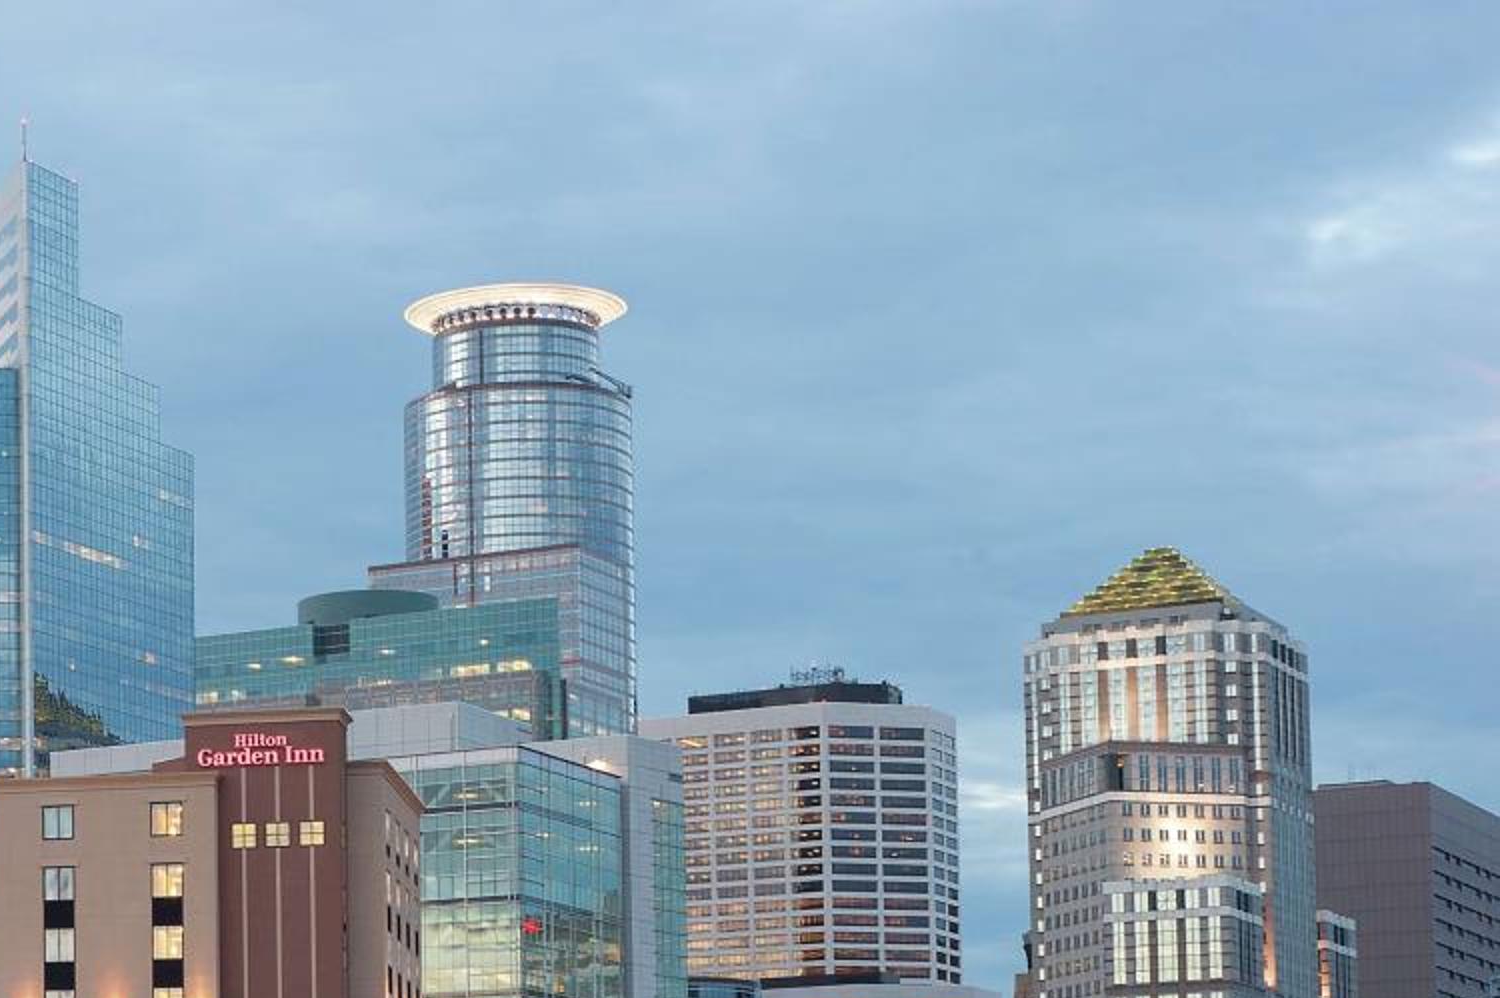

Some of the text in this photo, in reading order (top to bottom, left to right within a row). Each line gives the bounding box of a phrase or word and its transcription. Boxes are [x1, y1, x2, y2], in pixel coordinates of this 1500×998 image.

[234, 733, 288, 748] Hilton
[197, 746, 325, 767] Garden Inn
